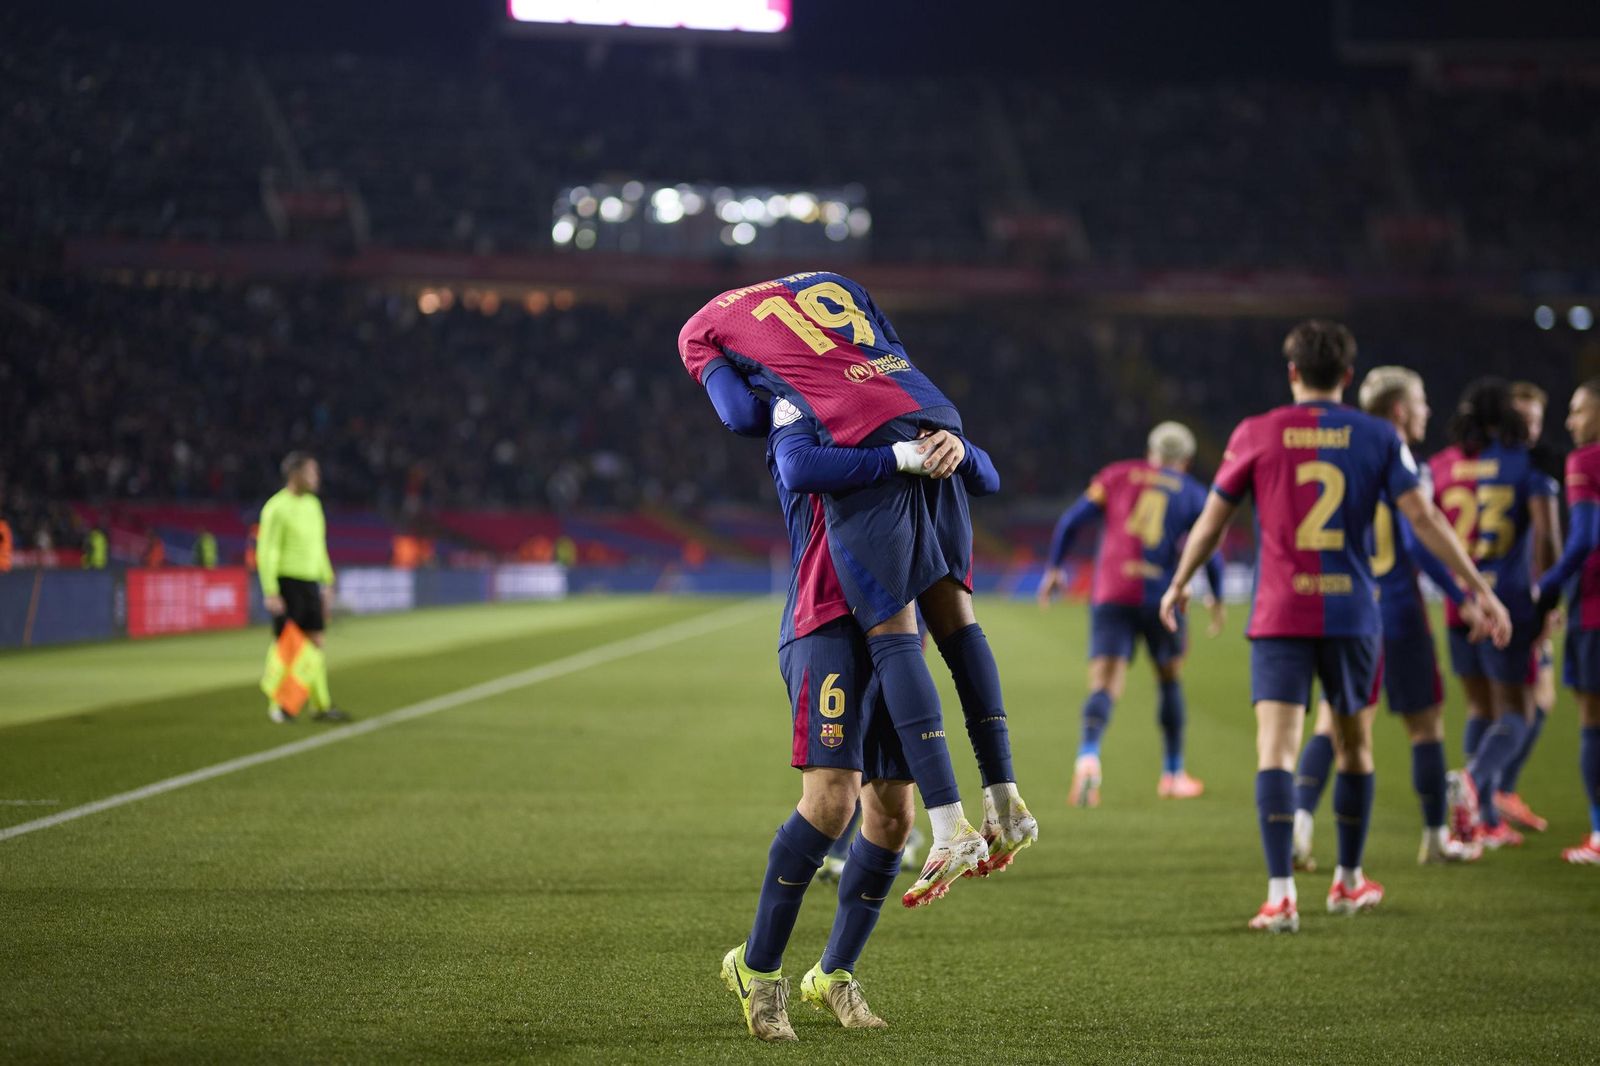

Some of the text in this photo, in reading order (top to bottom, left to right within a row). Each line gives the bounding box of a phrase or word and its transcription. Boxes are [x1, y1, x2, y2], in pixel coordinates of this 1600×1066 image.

[716, 281, 784, 308] LAMINE
[750, 281, 876, 356] 19
[875, 359, 910, 374] ACNUR
[1125, 488, 1168, 548] 4
[1295, 461, 1346, 551] 2
[1441, 484, 1515, 560] 23
[819, 673, 846, 719] 6
